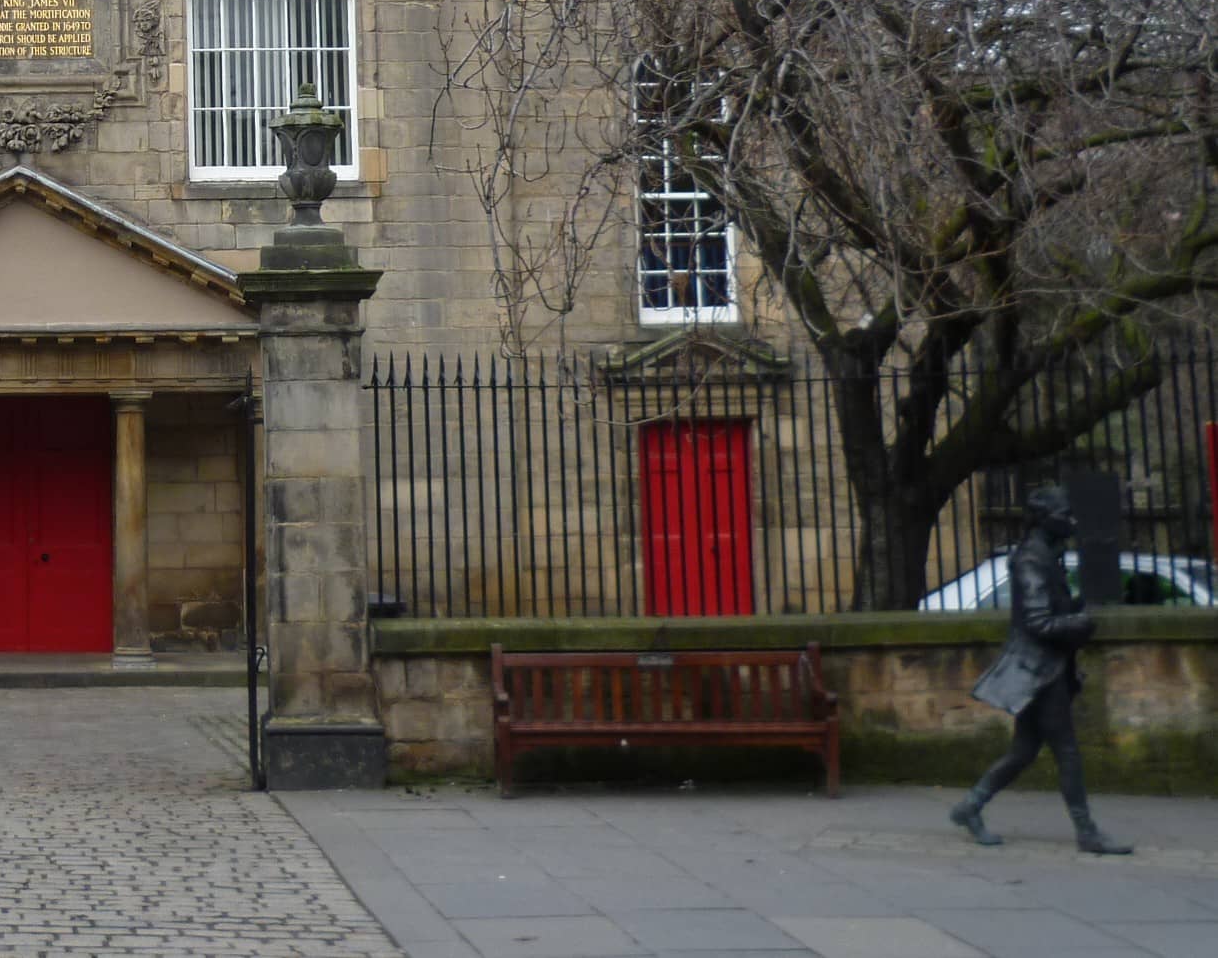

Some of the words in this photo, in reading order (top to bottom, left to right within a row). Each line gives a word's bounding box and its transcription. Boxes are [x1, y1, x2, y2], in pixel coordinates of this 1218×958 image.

[12, 9, 28, 19] THE
[30, 9, 91, 19] MORTIFICATION
[16, 22, 50, 32] GRANTED
[52, 22, 61, 31] IN
[63, 22, 81, 33] 1649
[81, 21, 92, 31] TO
[16, 34, 46, 44] SHOULD
[47, 34, 58, 43] BE
[58, 33, 92, 43] APPLIED
[17, 46, 28, 56] OF
[30, 46, 47, 56] THIS
[50, 45, 92, 56] STRUCTURE
